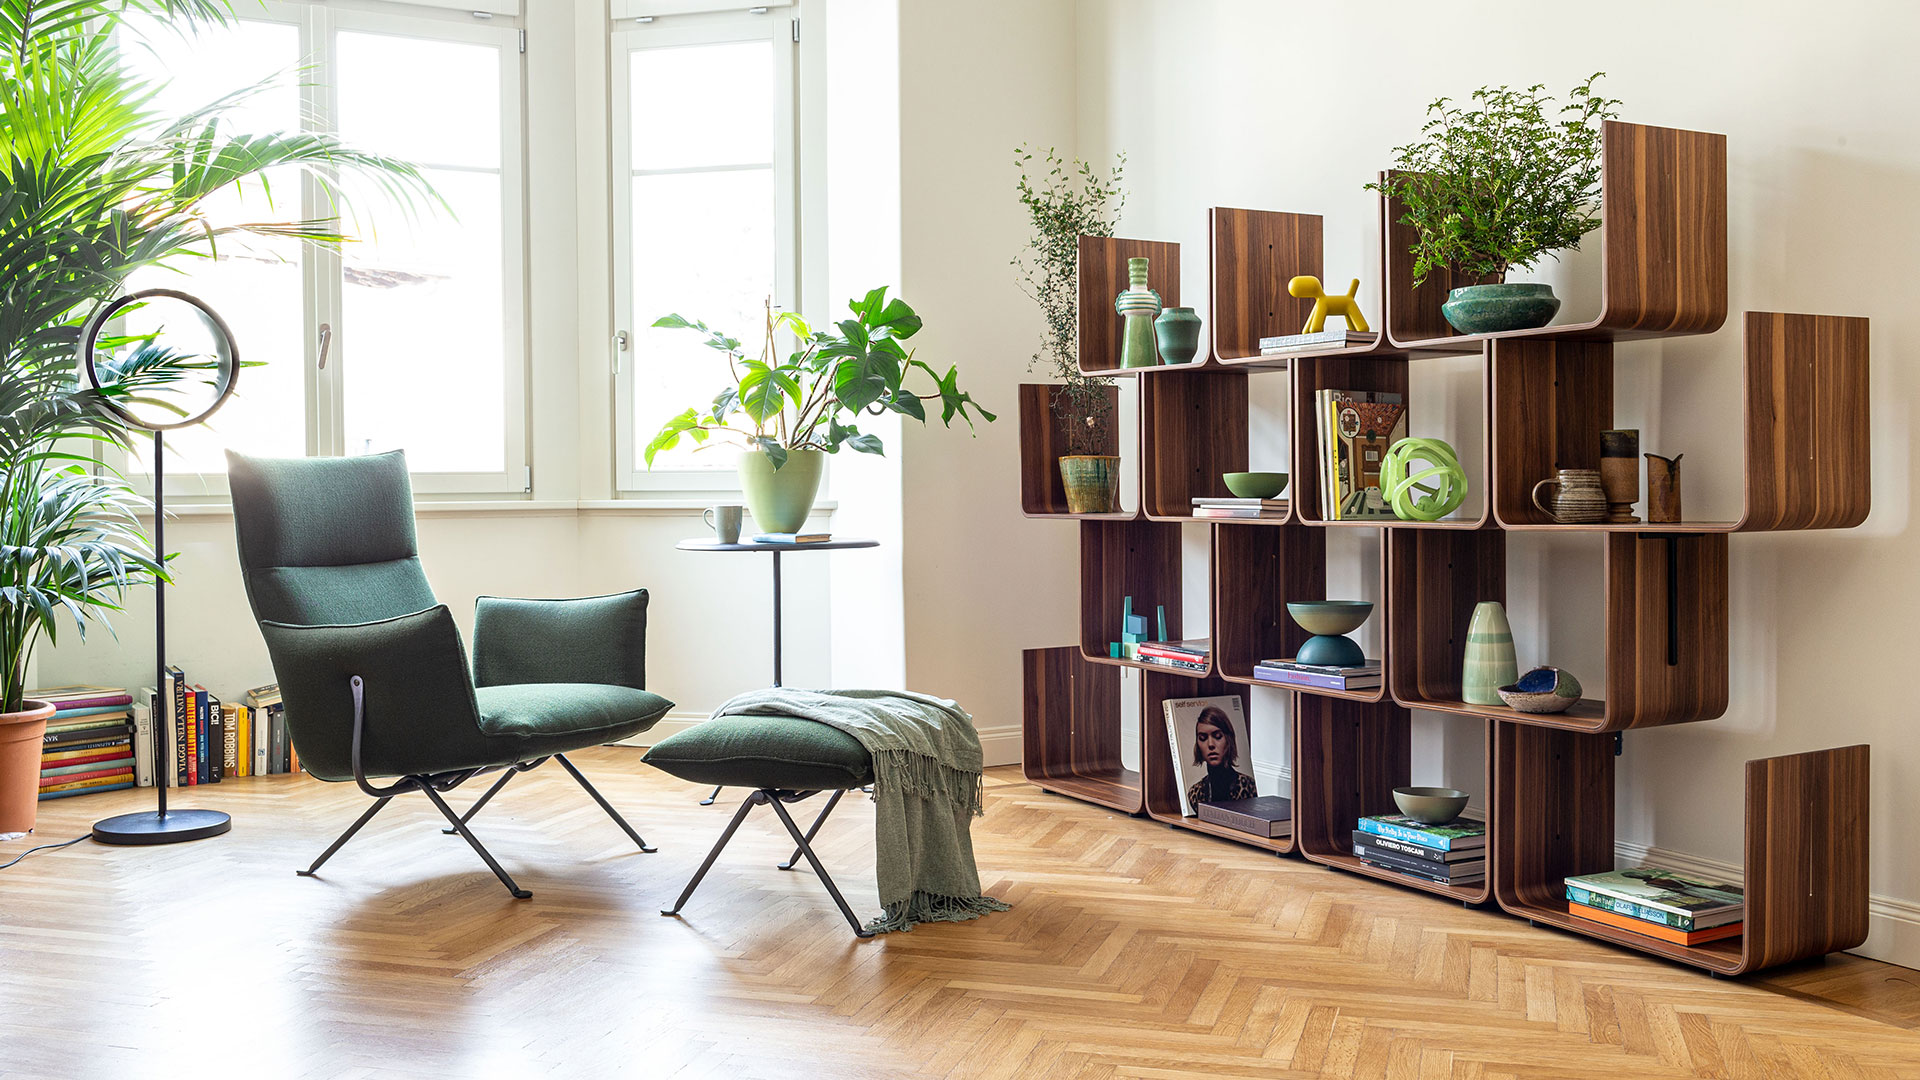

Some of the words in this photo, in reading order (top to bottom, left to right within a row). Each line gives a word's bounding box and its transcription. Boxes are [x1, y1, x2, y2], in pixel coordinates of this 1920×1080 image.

[176, 680, 184, 713] NATURA
[186, 696, 195, 723] WALTER
[177, 715, 185, 742] NELLA
[210, 705, 219, 725] BICI!
[224, 712, 236, 730] TOM
[187, 725, 196, 755] BONATTI
[223, 732, 235, 768] ROBBINS
[178, 744, 186, 772] VIAGGI
[1376, 839, 1400, 850] OLIVIERO
